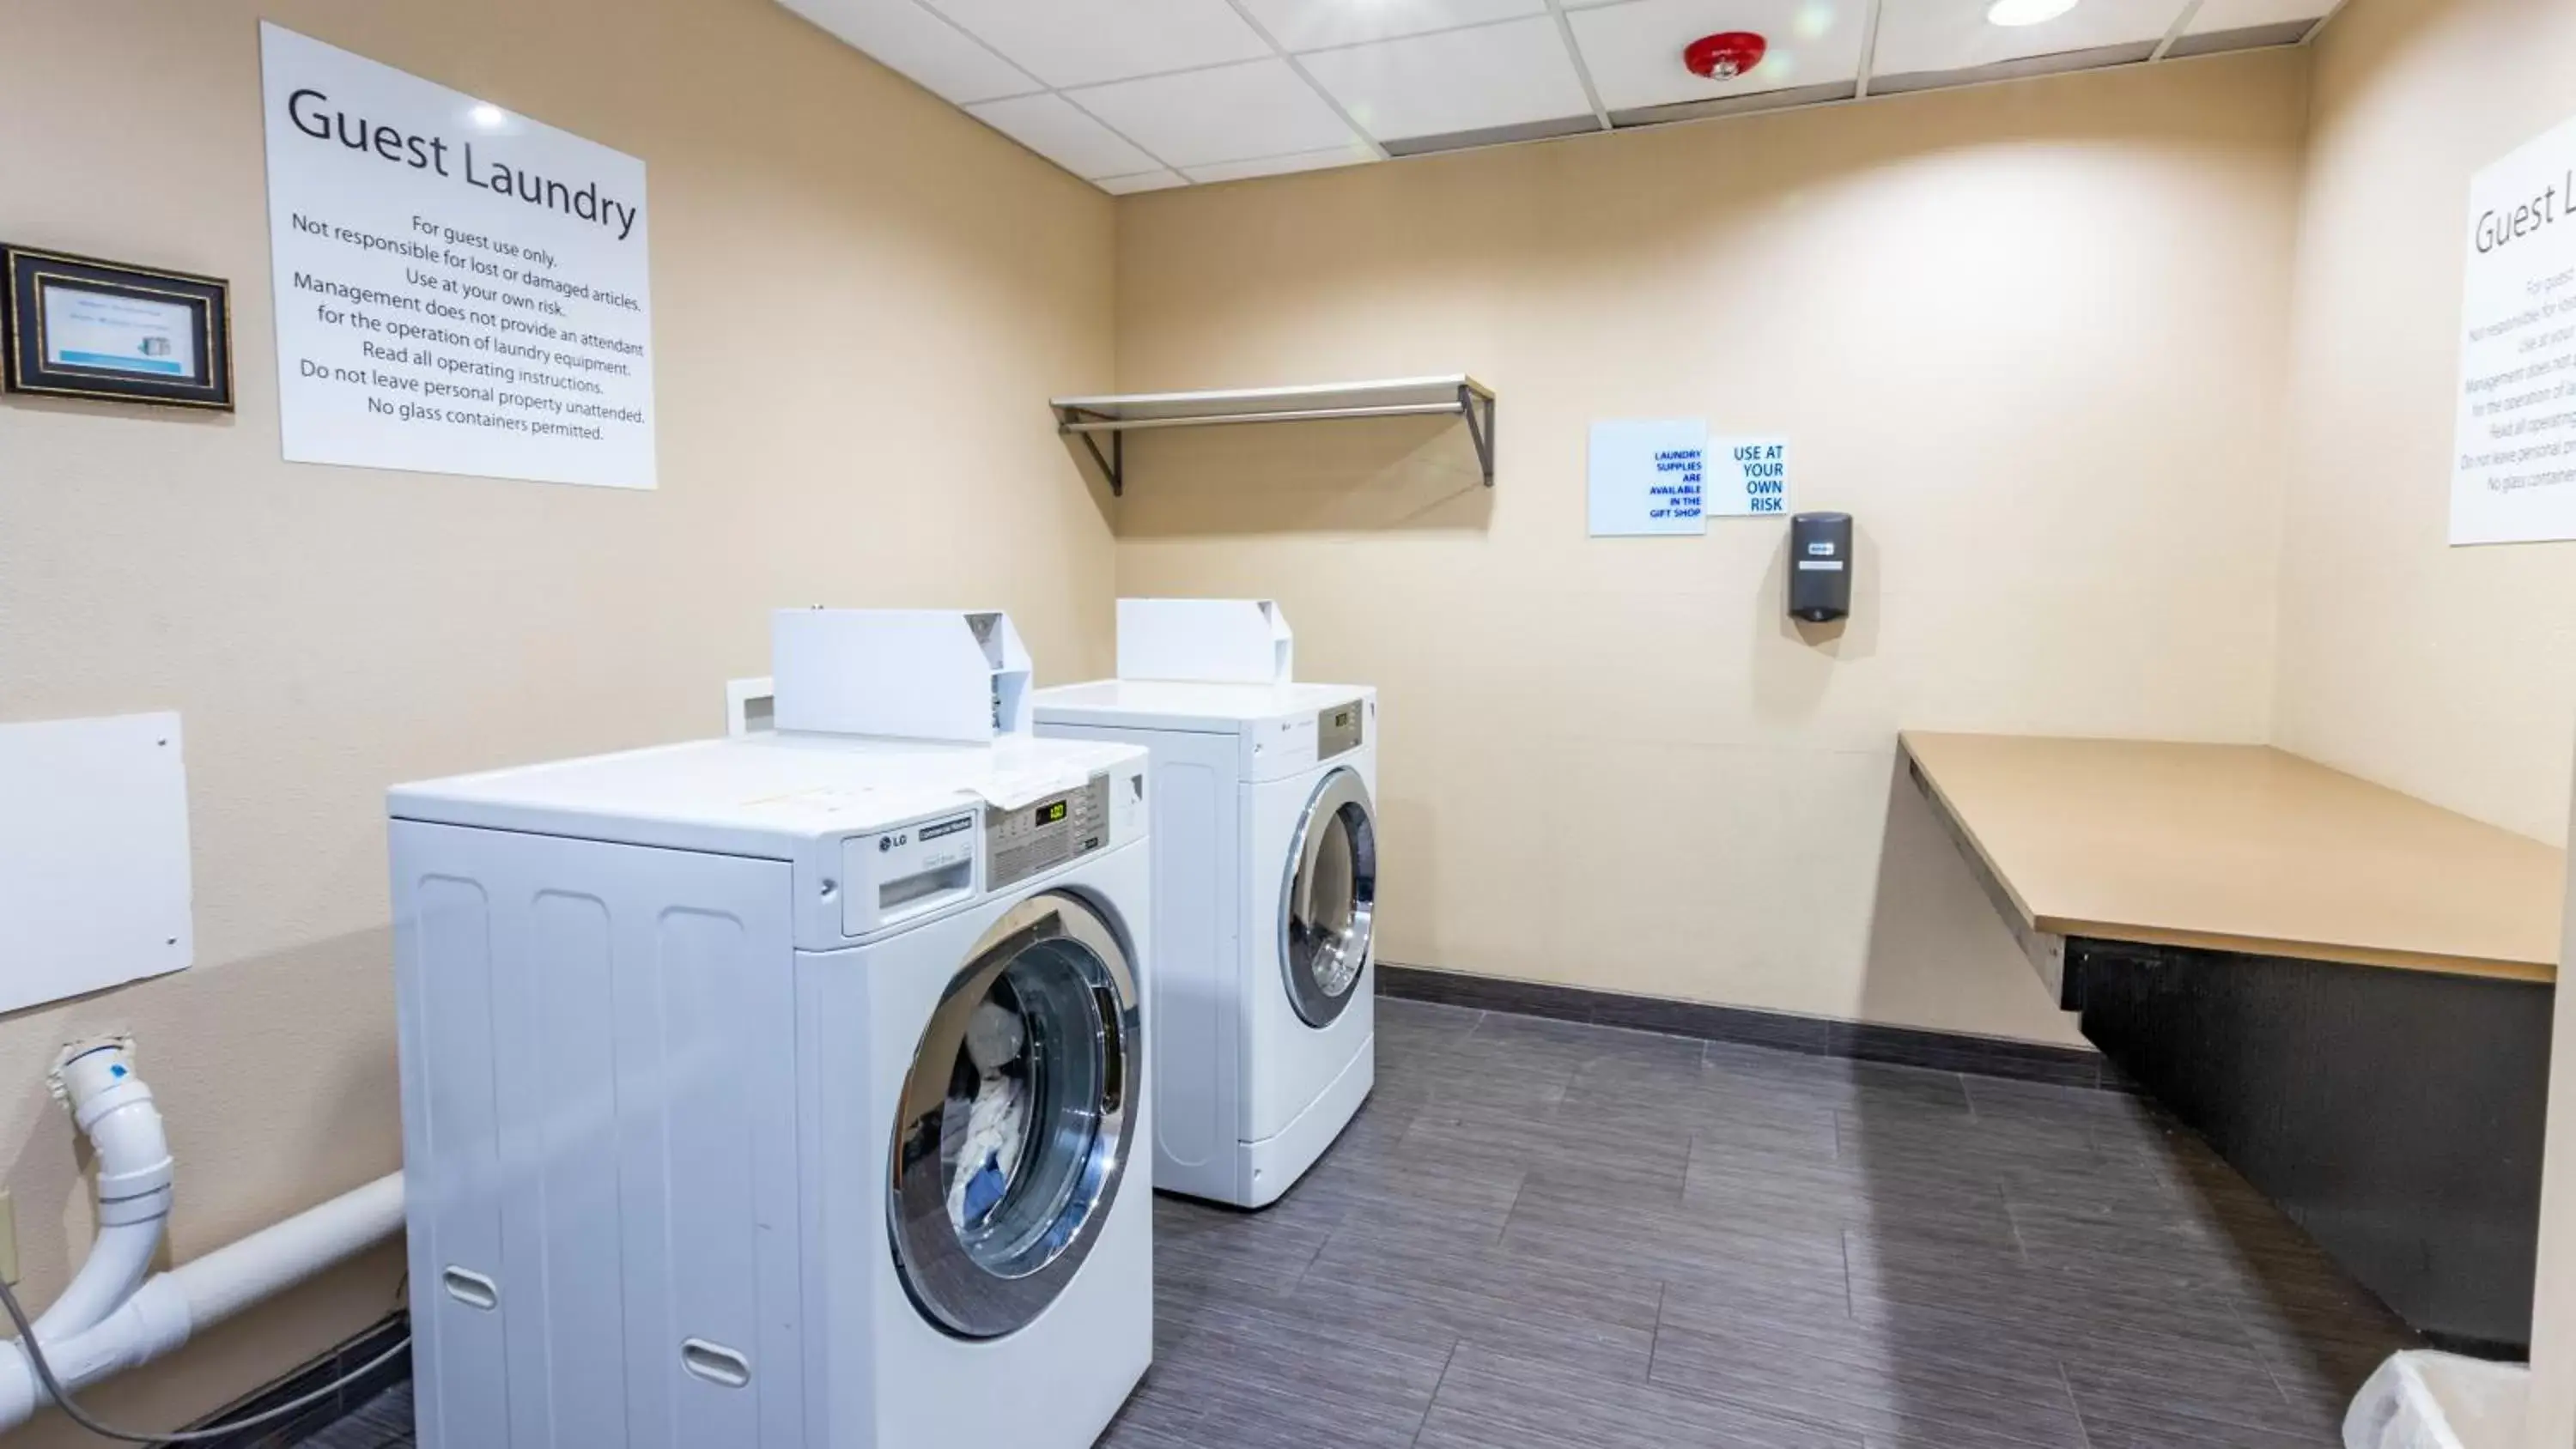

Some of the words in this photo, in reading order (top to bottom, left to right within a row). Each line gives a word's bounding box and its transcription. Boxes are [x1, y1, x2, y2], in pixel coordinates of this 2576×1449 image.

[289, 88, 450, 177] Guest
[465, 142, 637, 241] Laundry
[2476, 185, 2556, 253] Guest
[411, 215, 440, 236] For
[444, 227, 490, 250] guest
[493, 240, 519, 258] use
[522, 248, 558, 270] only.
[292, 212, 330, 238] Not
[334, 226, 440, 264] responsible
[443, 249, 466, 269] for
[471, 257, 499, 277] lost
[502, 268, 519, 282] or
[522, 270, 589, 300] damaged
[592, 289, 642, 312] articles.
[406, 266, 439, 289] Use
[442, 279, 459, 294] at
[462, 283, 498, 300] your
[501, 292, 535, 309] own
[538, 300, 565, 317] risk.
[293, 270, 422, 312] Management
[425, 298, 466, 320] does
[469, 302, 497, 326] not
[500, 315, 557, 340] provide
[559, 328, 577, 343] an
[580, 331, 644, 357] attendant
[316, 304, 345, 325] for
[349, 312, 382, 333] the
[386, 322, 471, 347] operation
[473, 335, 491, 351] of
[494, 336, 550, 365] laundry
[554, 352, 631, 377] equipment.
[362, 340, 408, 363] Read
[413, 349, 433, 367] all
[436, 356, 515, 384] operating
[518, 368, 604, 395] instructions.
[301, 357, 330, 379] Do
[335, 367, 368, 385] not
[372, 368, 420, 392] leave
[424, 380, 495, 403] personal
[499, 391, 563, 415] property
[566, 400, 645, 424] unattended.
[368, 396, 395, 415] No
[398, 401, 443, 422] glass
[446, 410, 529, 432] containers
[531, 421, 604, 440] permitted.
[1654, 449, 1702, 461] LAUNDRY
[1656, 461, 1703, 471] SUPPLIES
[1734, 445, 1761, 461] USE
[1765, 445, 1783, 459] AT
[1682, 473, 1702, 482] ARE
[1743, 463, 1783, 477] YOUR
[1649, 485, 1702, 494] AVAILABLE
[1669, 497, 1680, 506] IN
[1683, 497, 1702, 506] THE
[1746, 480, 1783, 495] OWN
[1649, 508, 1671, 518] GIFT
[1674, 507, 1702, 518] SHOP
[1750, 497, 1783, 512] RISK
